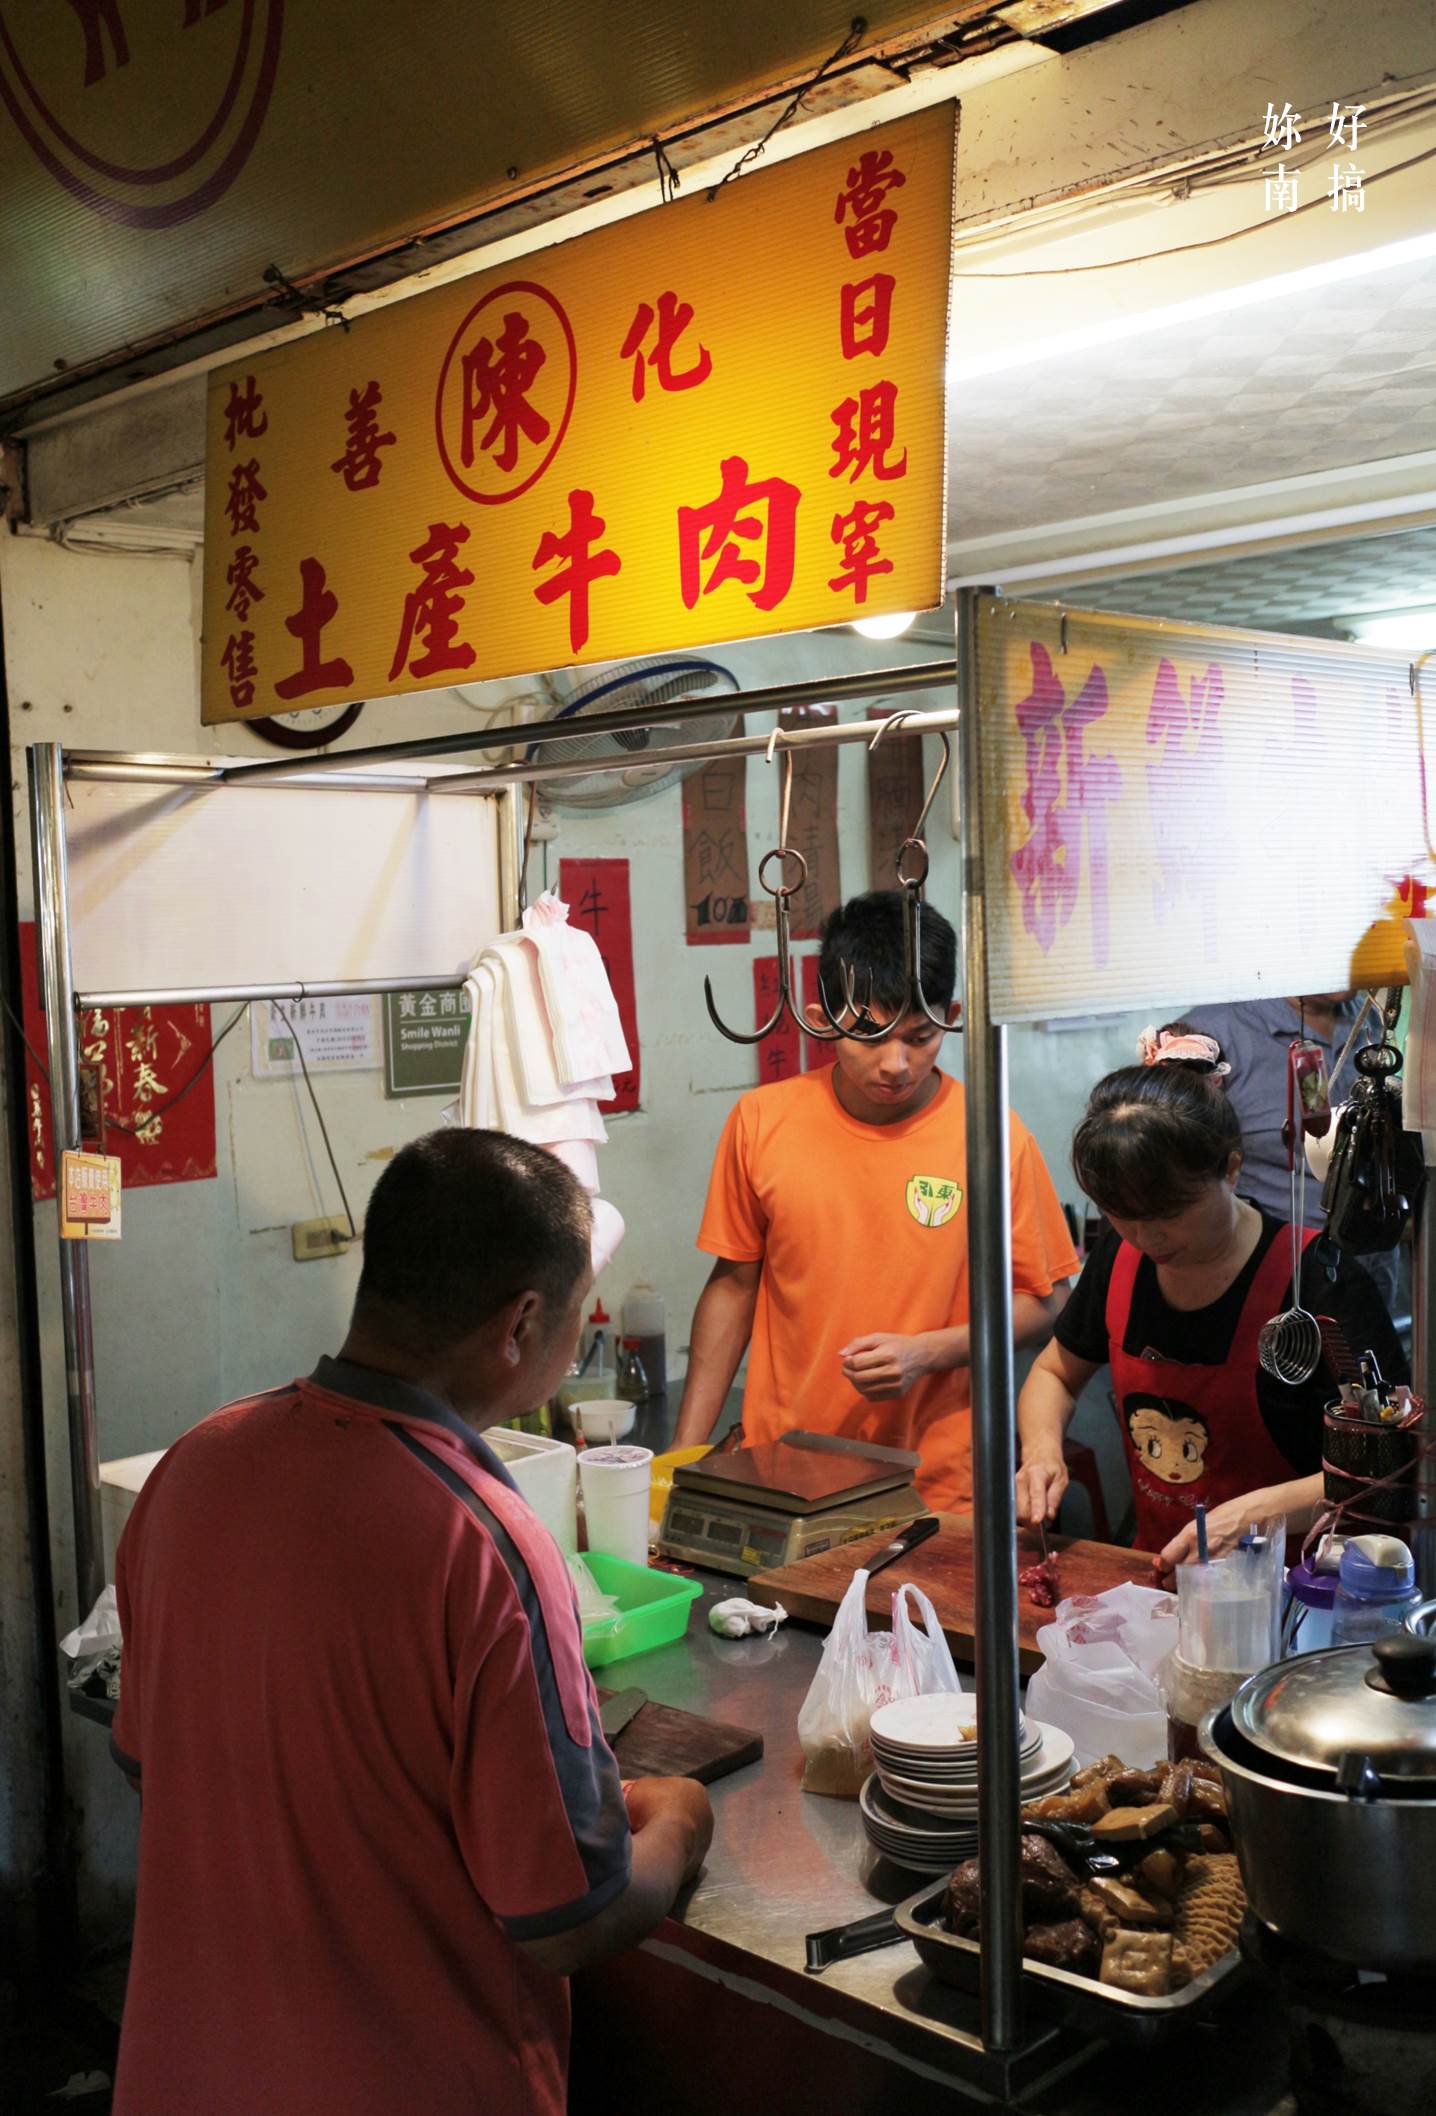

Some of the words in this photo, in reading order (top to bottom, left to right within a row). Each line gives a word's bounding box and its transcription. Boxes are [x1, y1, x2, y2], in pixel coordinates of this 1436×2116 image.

[828, 150, 907, 604] 當日現宰
[219, 375, 268, 709] 批發零售
[274, 456, 802, 703] 土產牛肉
[400, 1026, 430, 1040] Smile
[431, 1024, 461, 1038] Wanli
